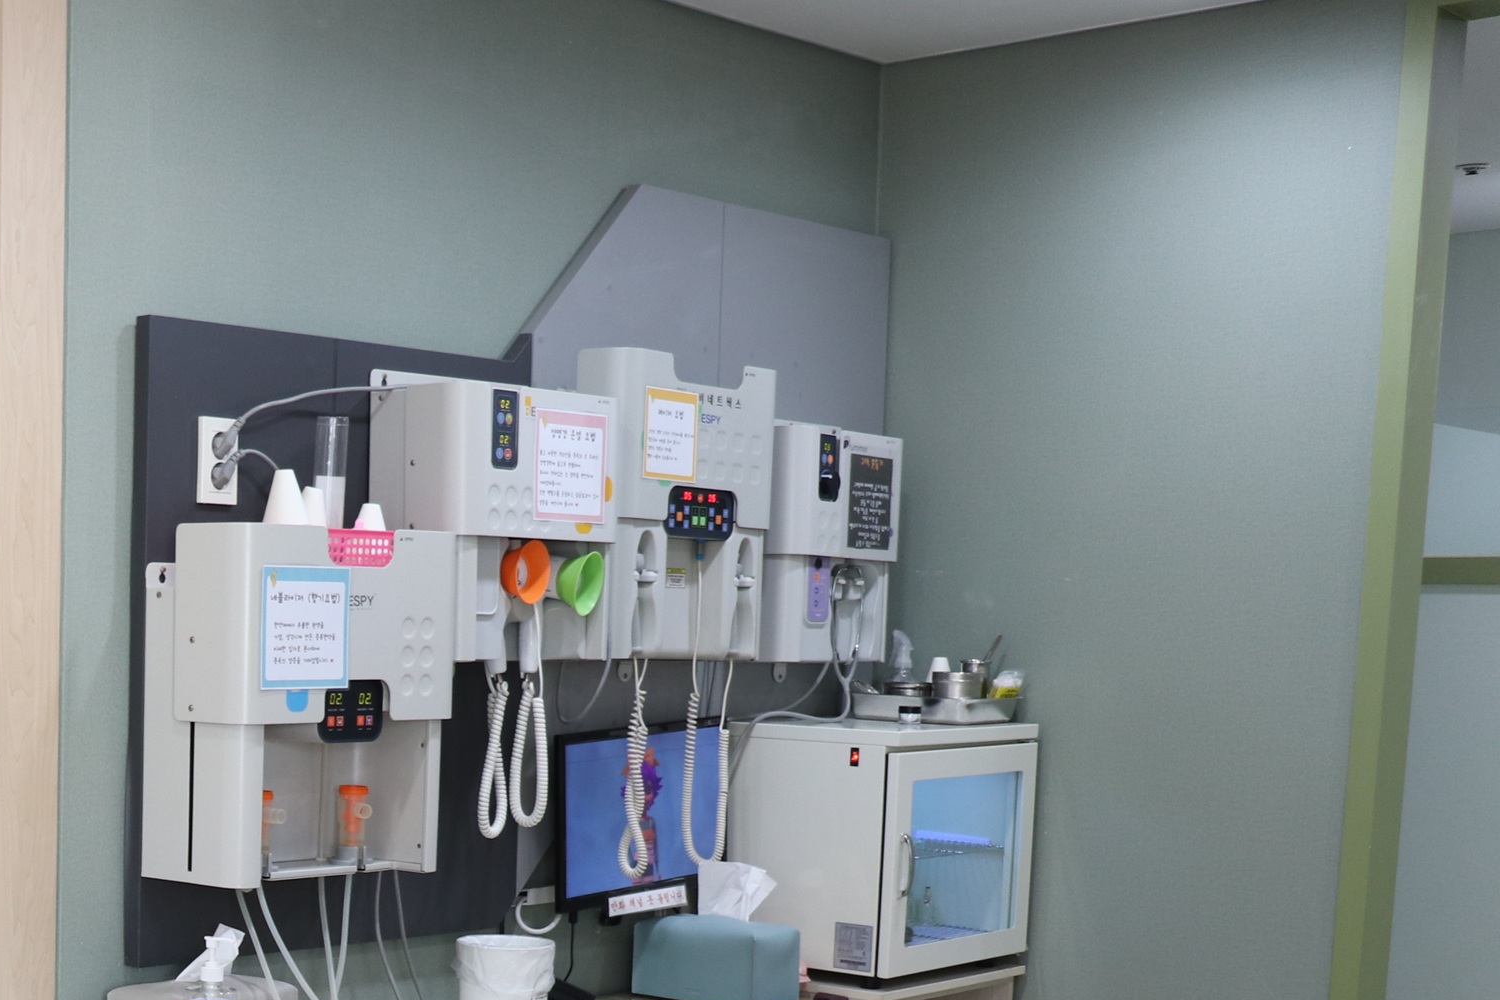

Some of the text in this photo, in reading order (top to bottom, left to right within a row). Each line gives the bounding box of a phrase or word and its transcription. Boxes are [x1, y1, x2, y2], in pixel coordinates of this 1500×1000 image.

[674, 410, 684, 420] 요법
[584, 431, 596, 442] 요법
[271, 592, 340, 604] 네블라이저 (향기요법)
